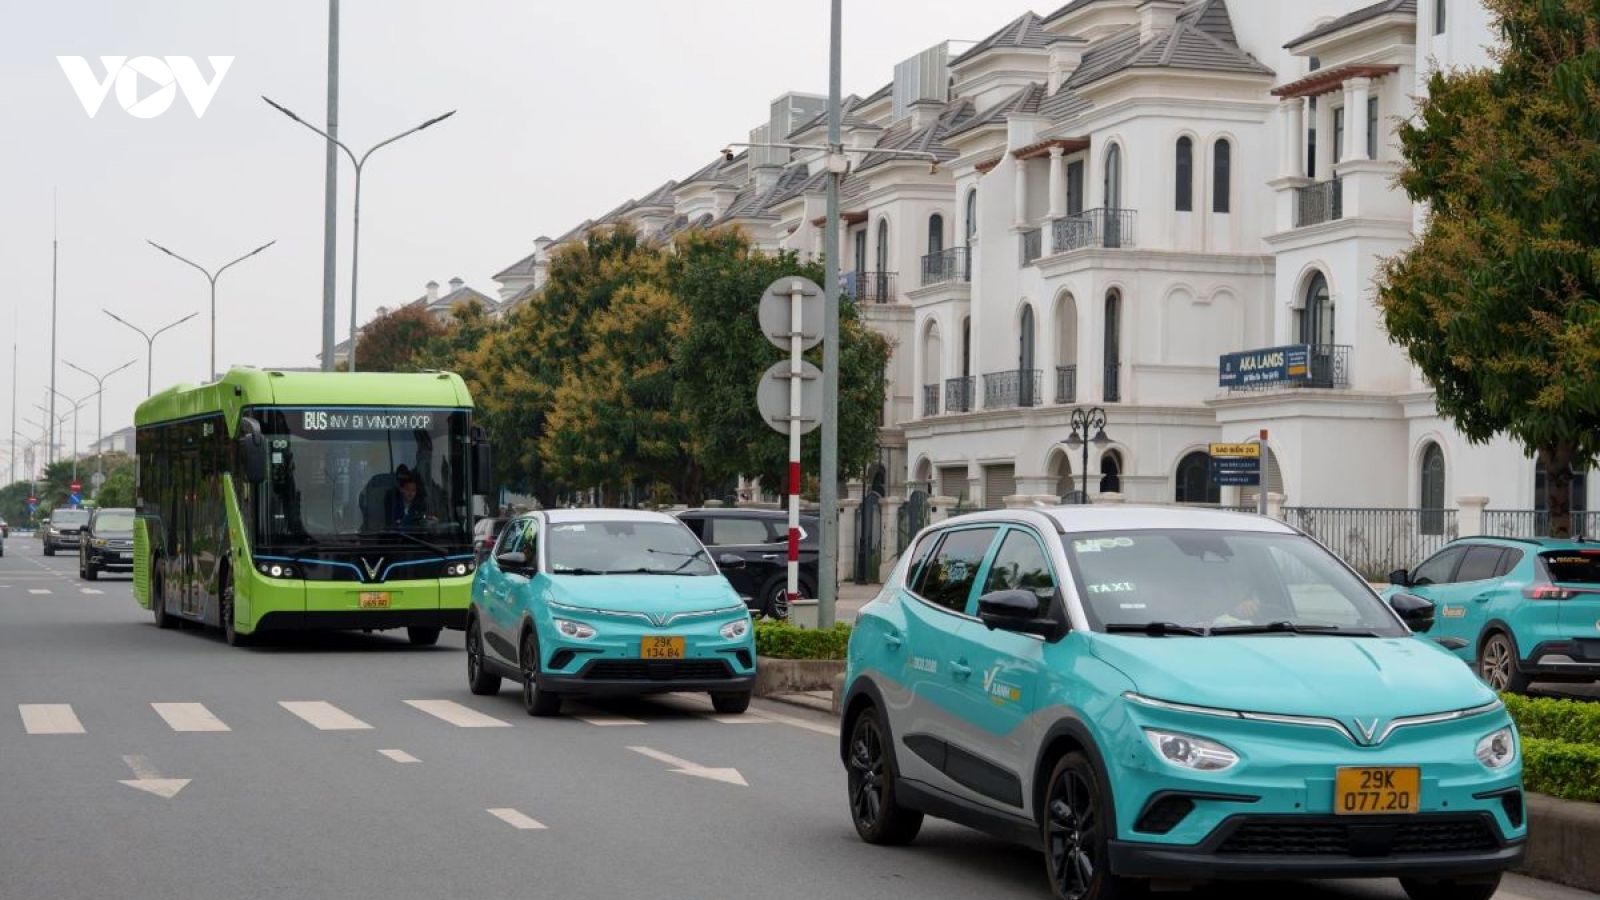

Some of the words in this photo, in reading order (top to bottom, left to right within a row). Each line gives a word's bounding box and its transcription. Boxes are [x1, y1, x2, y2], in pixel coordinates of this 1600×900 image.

[1240, 356, 1256, 372] AKA
[1257, 351, 1284, 369] LANDS
[304, 411, 328, 430] BUS
[366, 415, 408, 429] VINCOM
[1088, 582, 1134, 593] TAXI
[653, 636, 673, 647] 29K
[1360, 770, 1395, 789] 29K
[1344, 791, 1409, 811] 077.20
